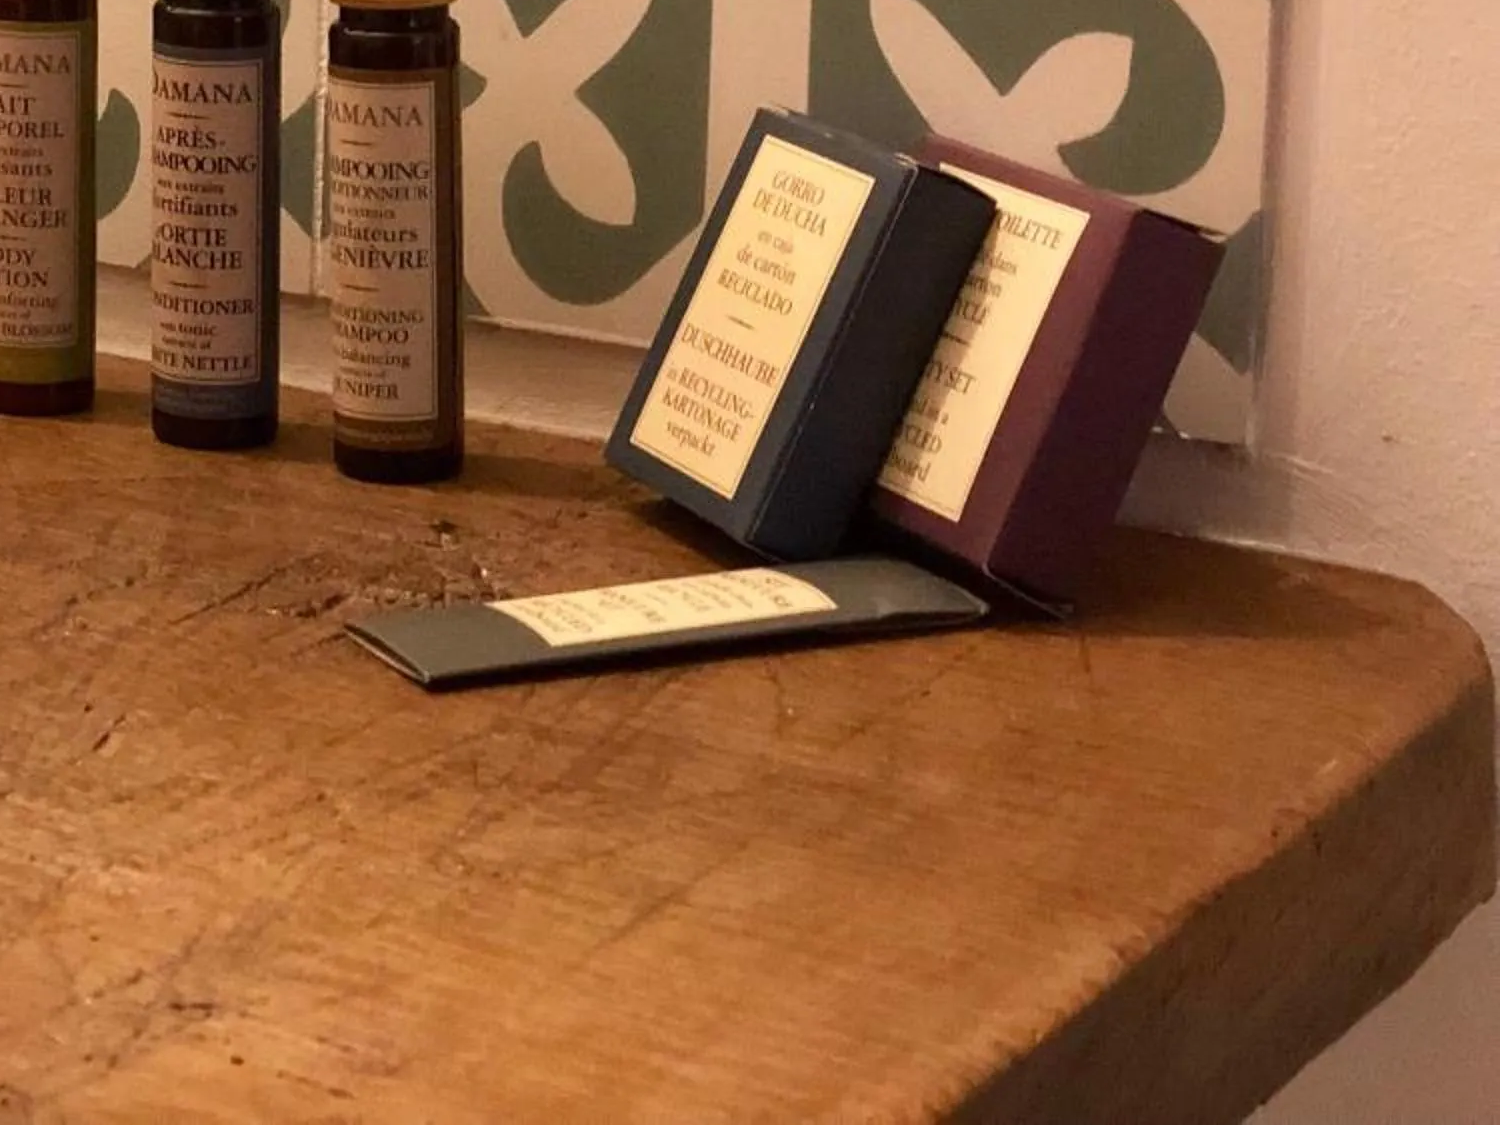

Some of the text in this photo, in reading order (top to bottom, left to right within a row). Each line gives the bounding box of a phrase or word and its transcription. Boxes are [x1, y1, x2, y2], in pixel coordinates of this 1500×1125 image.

[153, 147, 258, 175] AMPOOING
[772, 195, 827, 238] DUCHA
[995, 209, 1065, 250] OILETTE
[153, 290, 255, 317] NDITIONER
[716, 268, 794, 316] RECICLADO
[680, 322, 781, 389] DUSCHHAUBE
[335, 376, 400, 400] UNIPER
[661, 386, 742, 443] KARTONAGE
